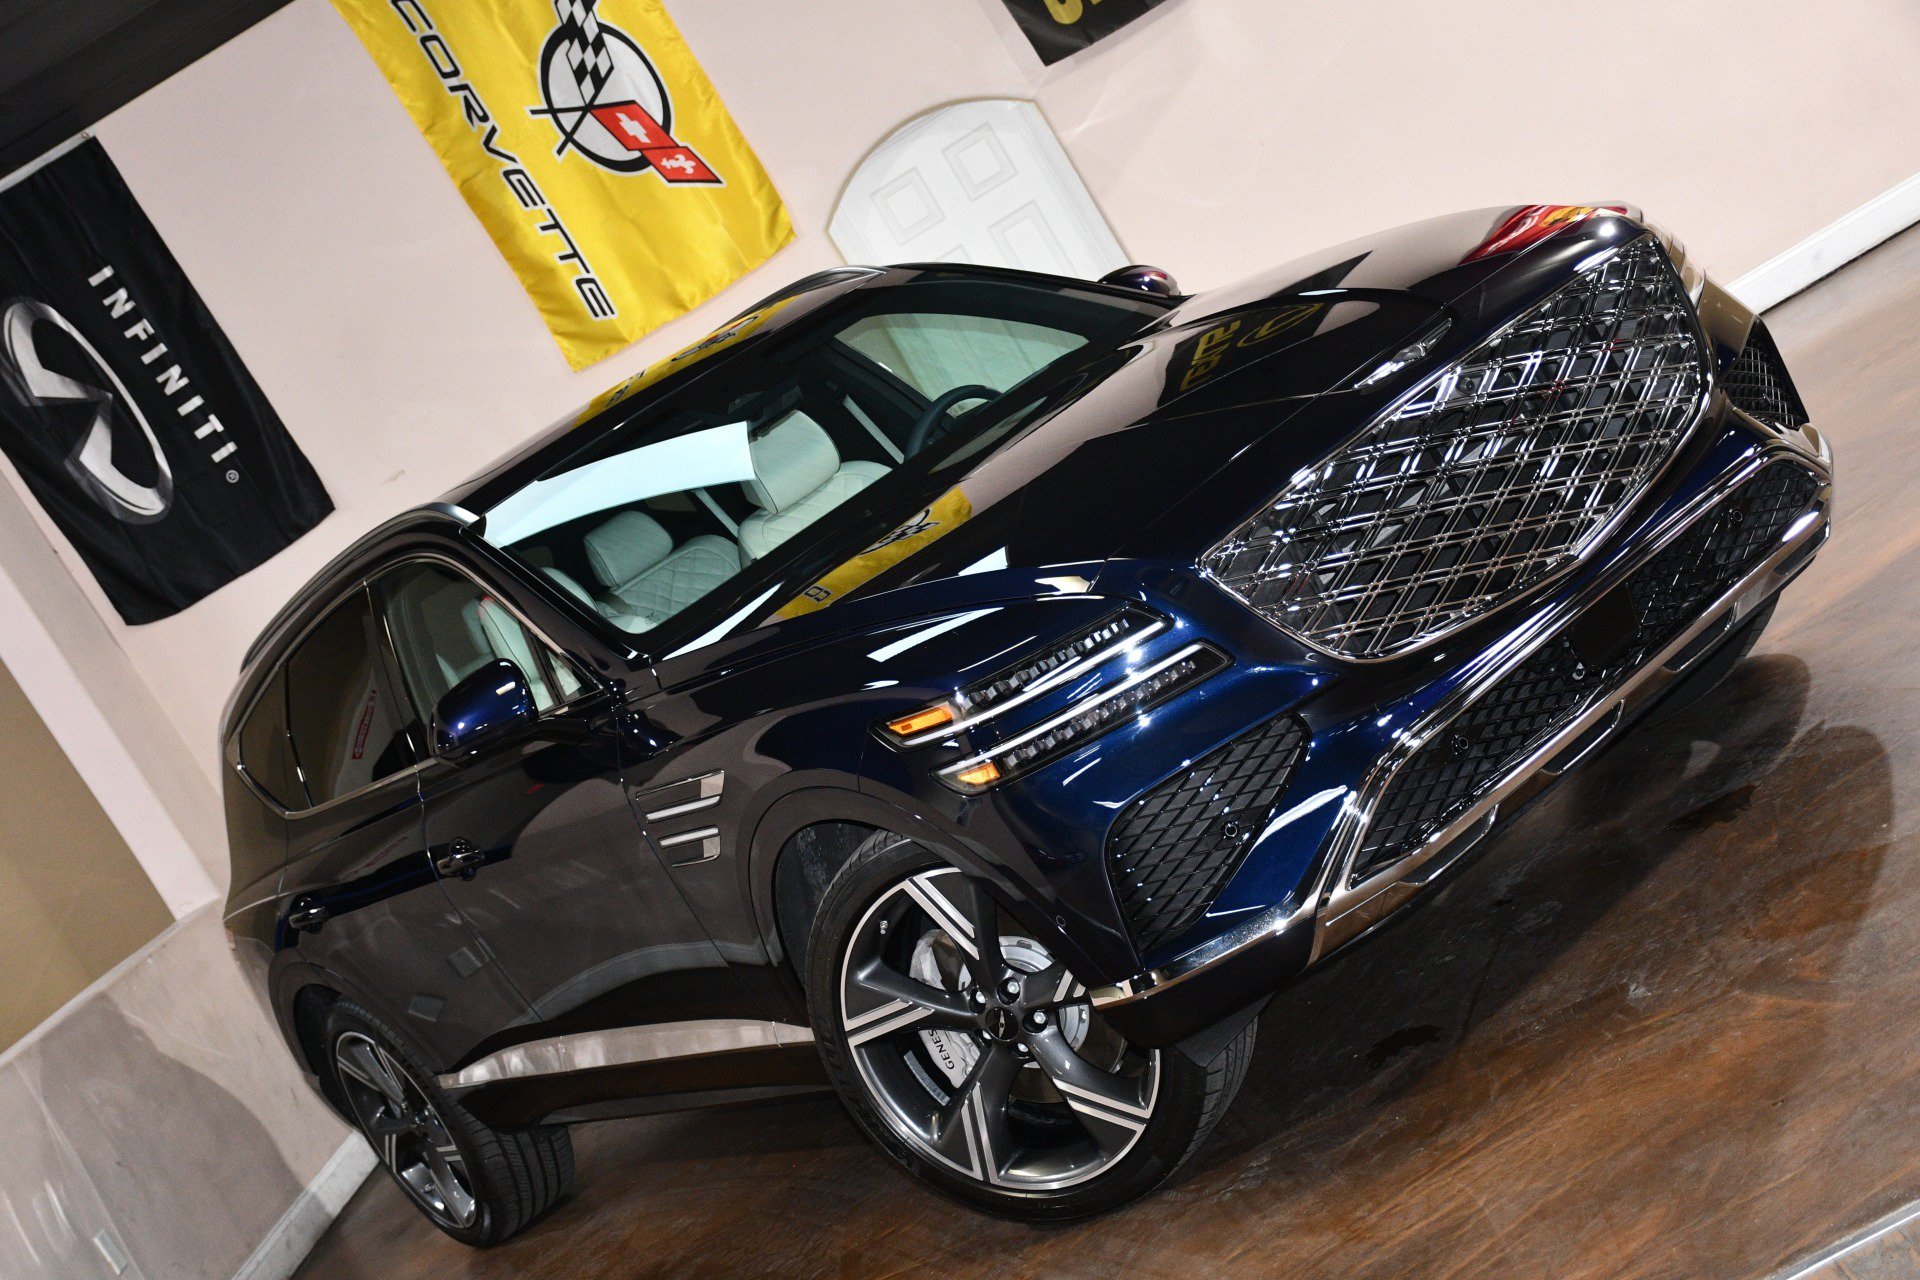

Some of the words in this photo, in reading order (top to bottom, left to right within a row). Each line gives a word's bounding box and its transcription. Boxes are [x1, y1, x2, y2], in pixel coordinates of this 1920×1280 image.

[390, 0, 616, 319] CORVETTE
[88, 265, 238, 463] INFINITI
[928, 1029, 955, 1070] GENES
